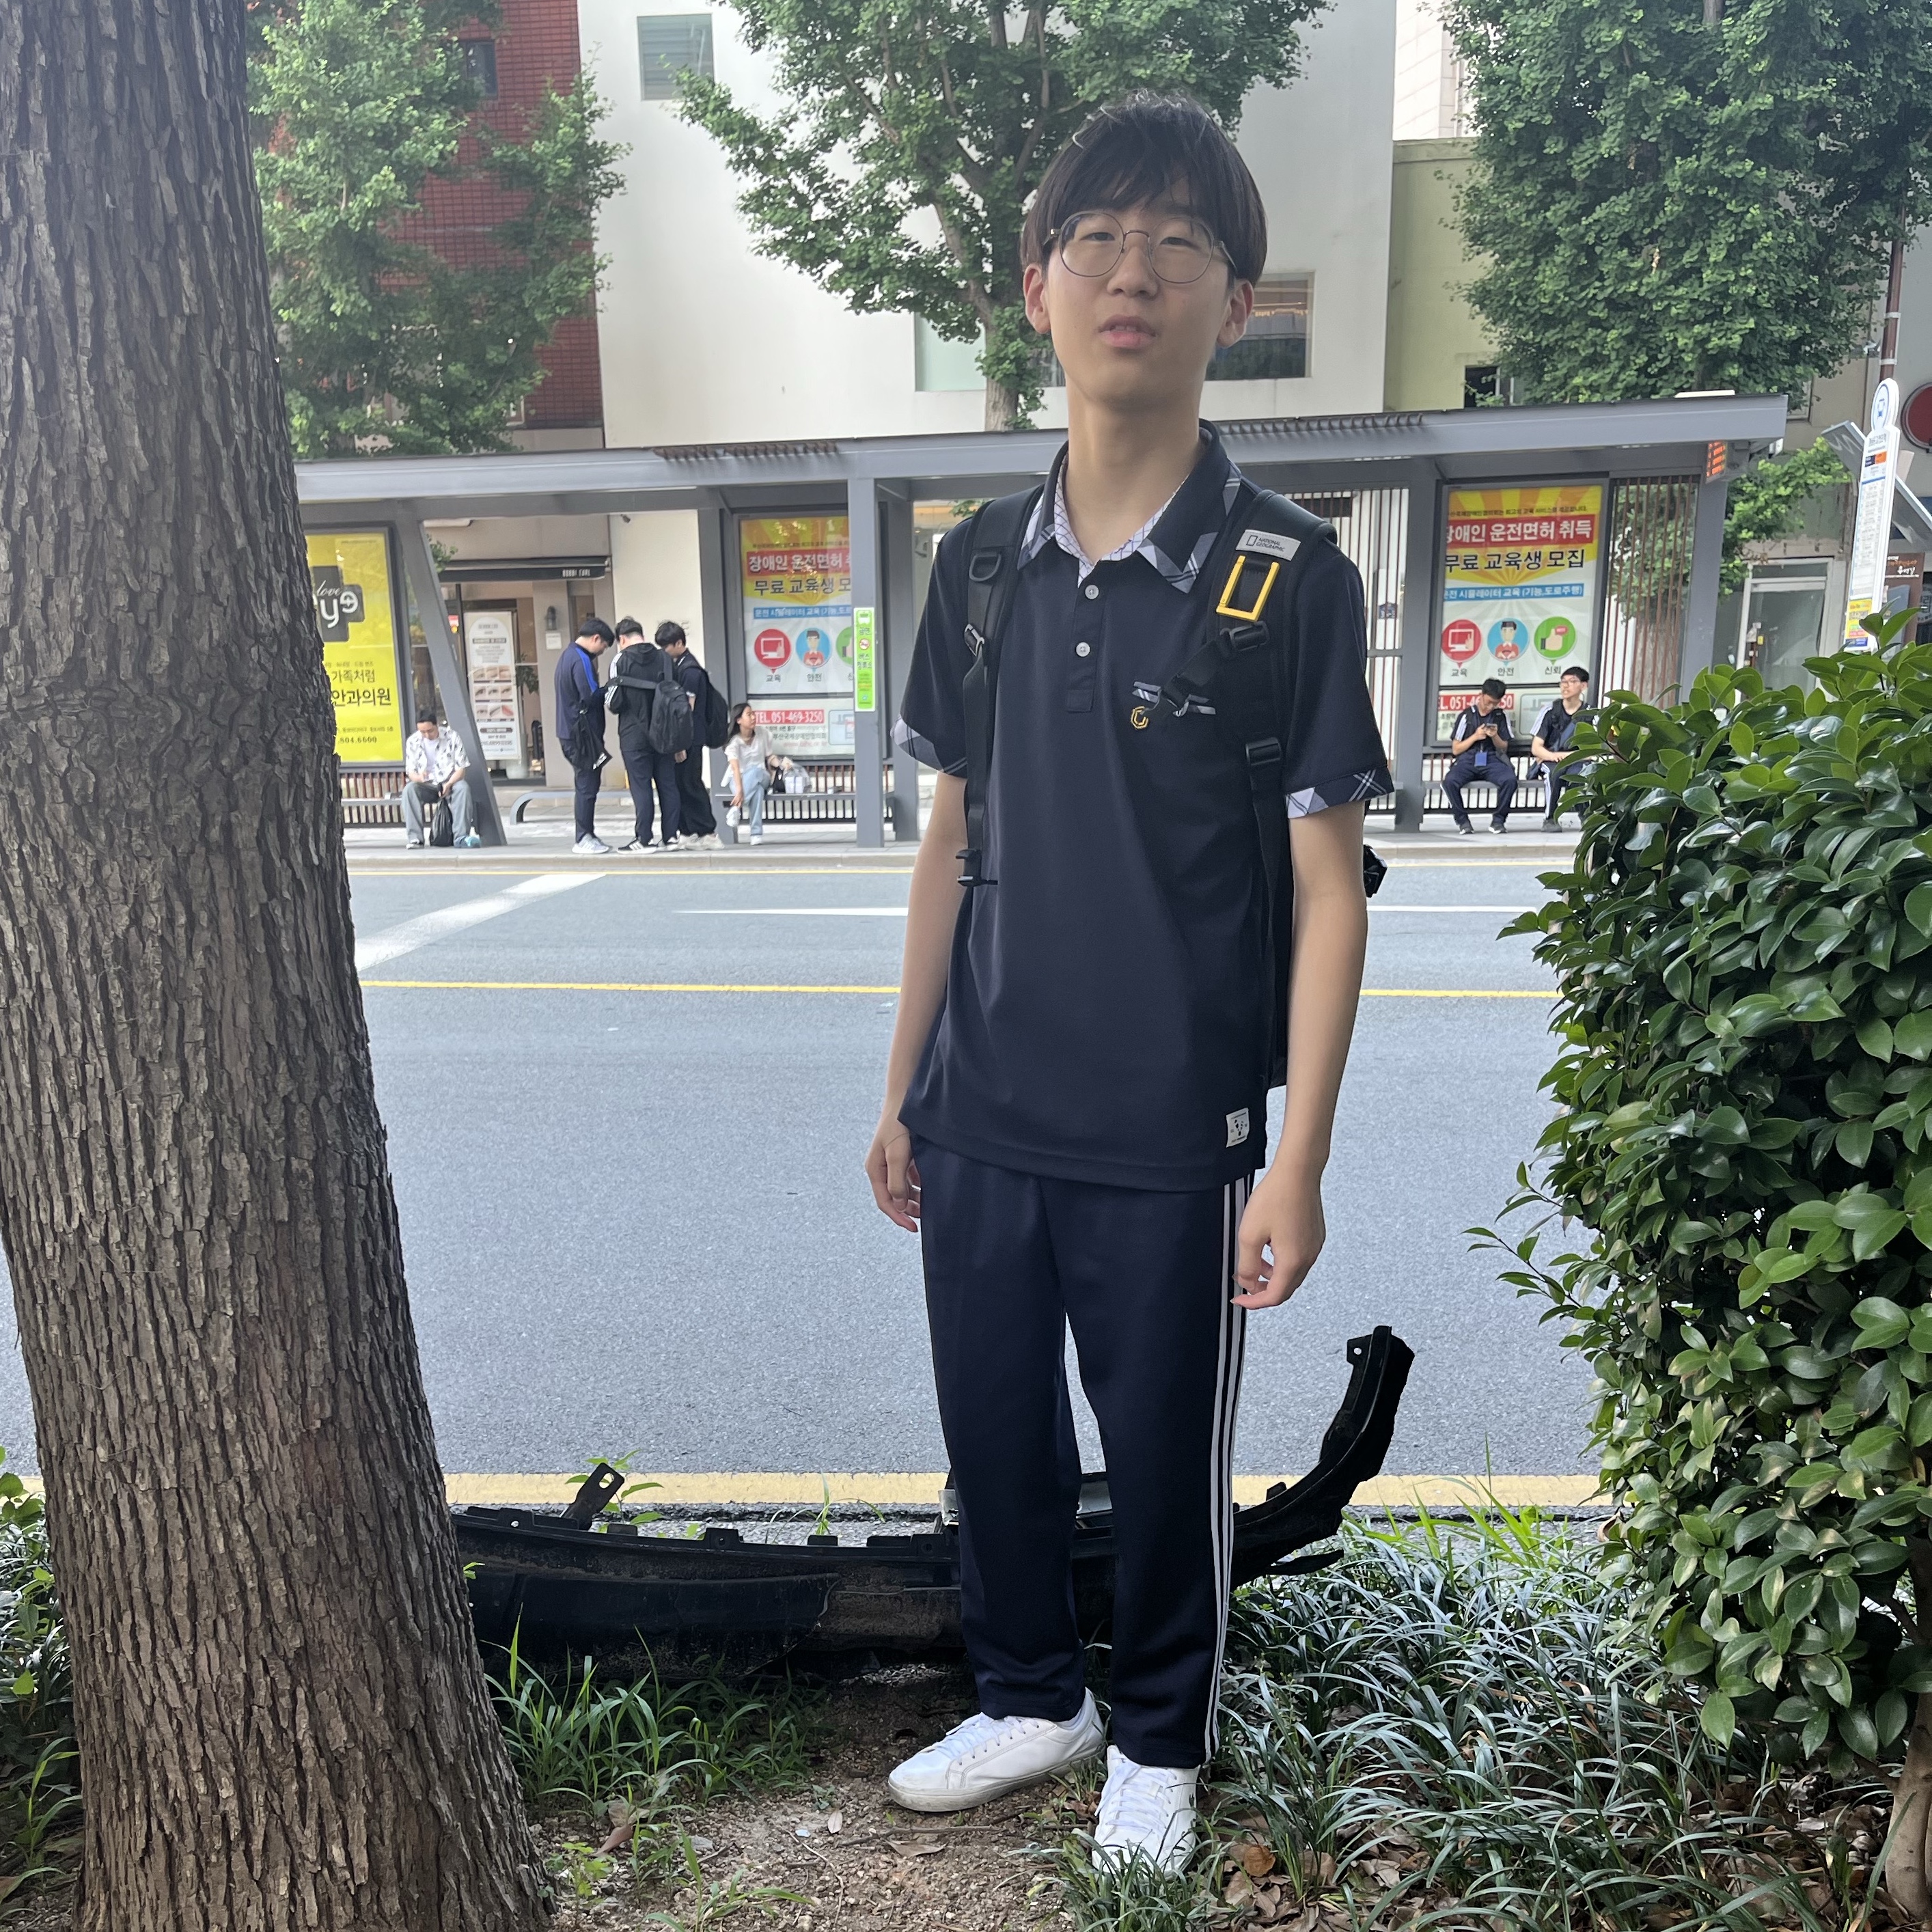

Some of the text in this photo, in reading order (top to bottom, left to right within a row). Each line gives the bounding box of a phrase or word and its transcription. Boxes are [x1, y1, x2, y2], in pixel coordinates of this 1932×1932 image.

[1490, 521, 1555, 542] 운전면허
[1559, 519, 1592, 539] 취득
[1258, 537, 1282, 546] NATIONAL
[1256, 542, 1286, 552] GEOGRAPHIC
[749, 555, 788, 572] 장애인
[792, 553, 842, 572] 운전면허
[1445, 549, 1584, 572] 무료 교육생 모집
[316, 579, 342, 597] love
[754, 578, 851, 596] 무료 교육생 모
[1459, 588, 1502, 598] 시뮬레이터
[1503, 588, 1521, 598] 교육
[1451, 668, 1468, 677] 교육
[1498, 667, 1515, 676] 안전
[1545, 665, 1562, 675] 신뢰
[332, 669, 375, 683] 가족처럼
[766, 674, 781, 682] 교육
[807, 673, 823, 682] 안전
[331, 687, 391, 707] 안과의원
